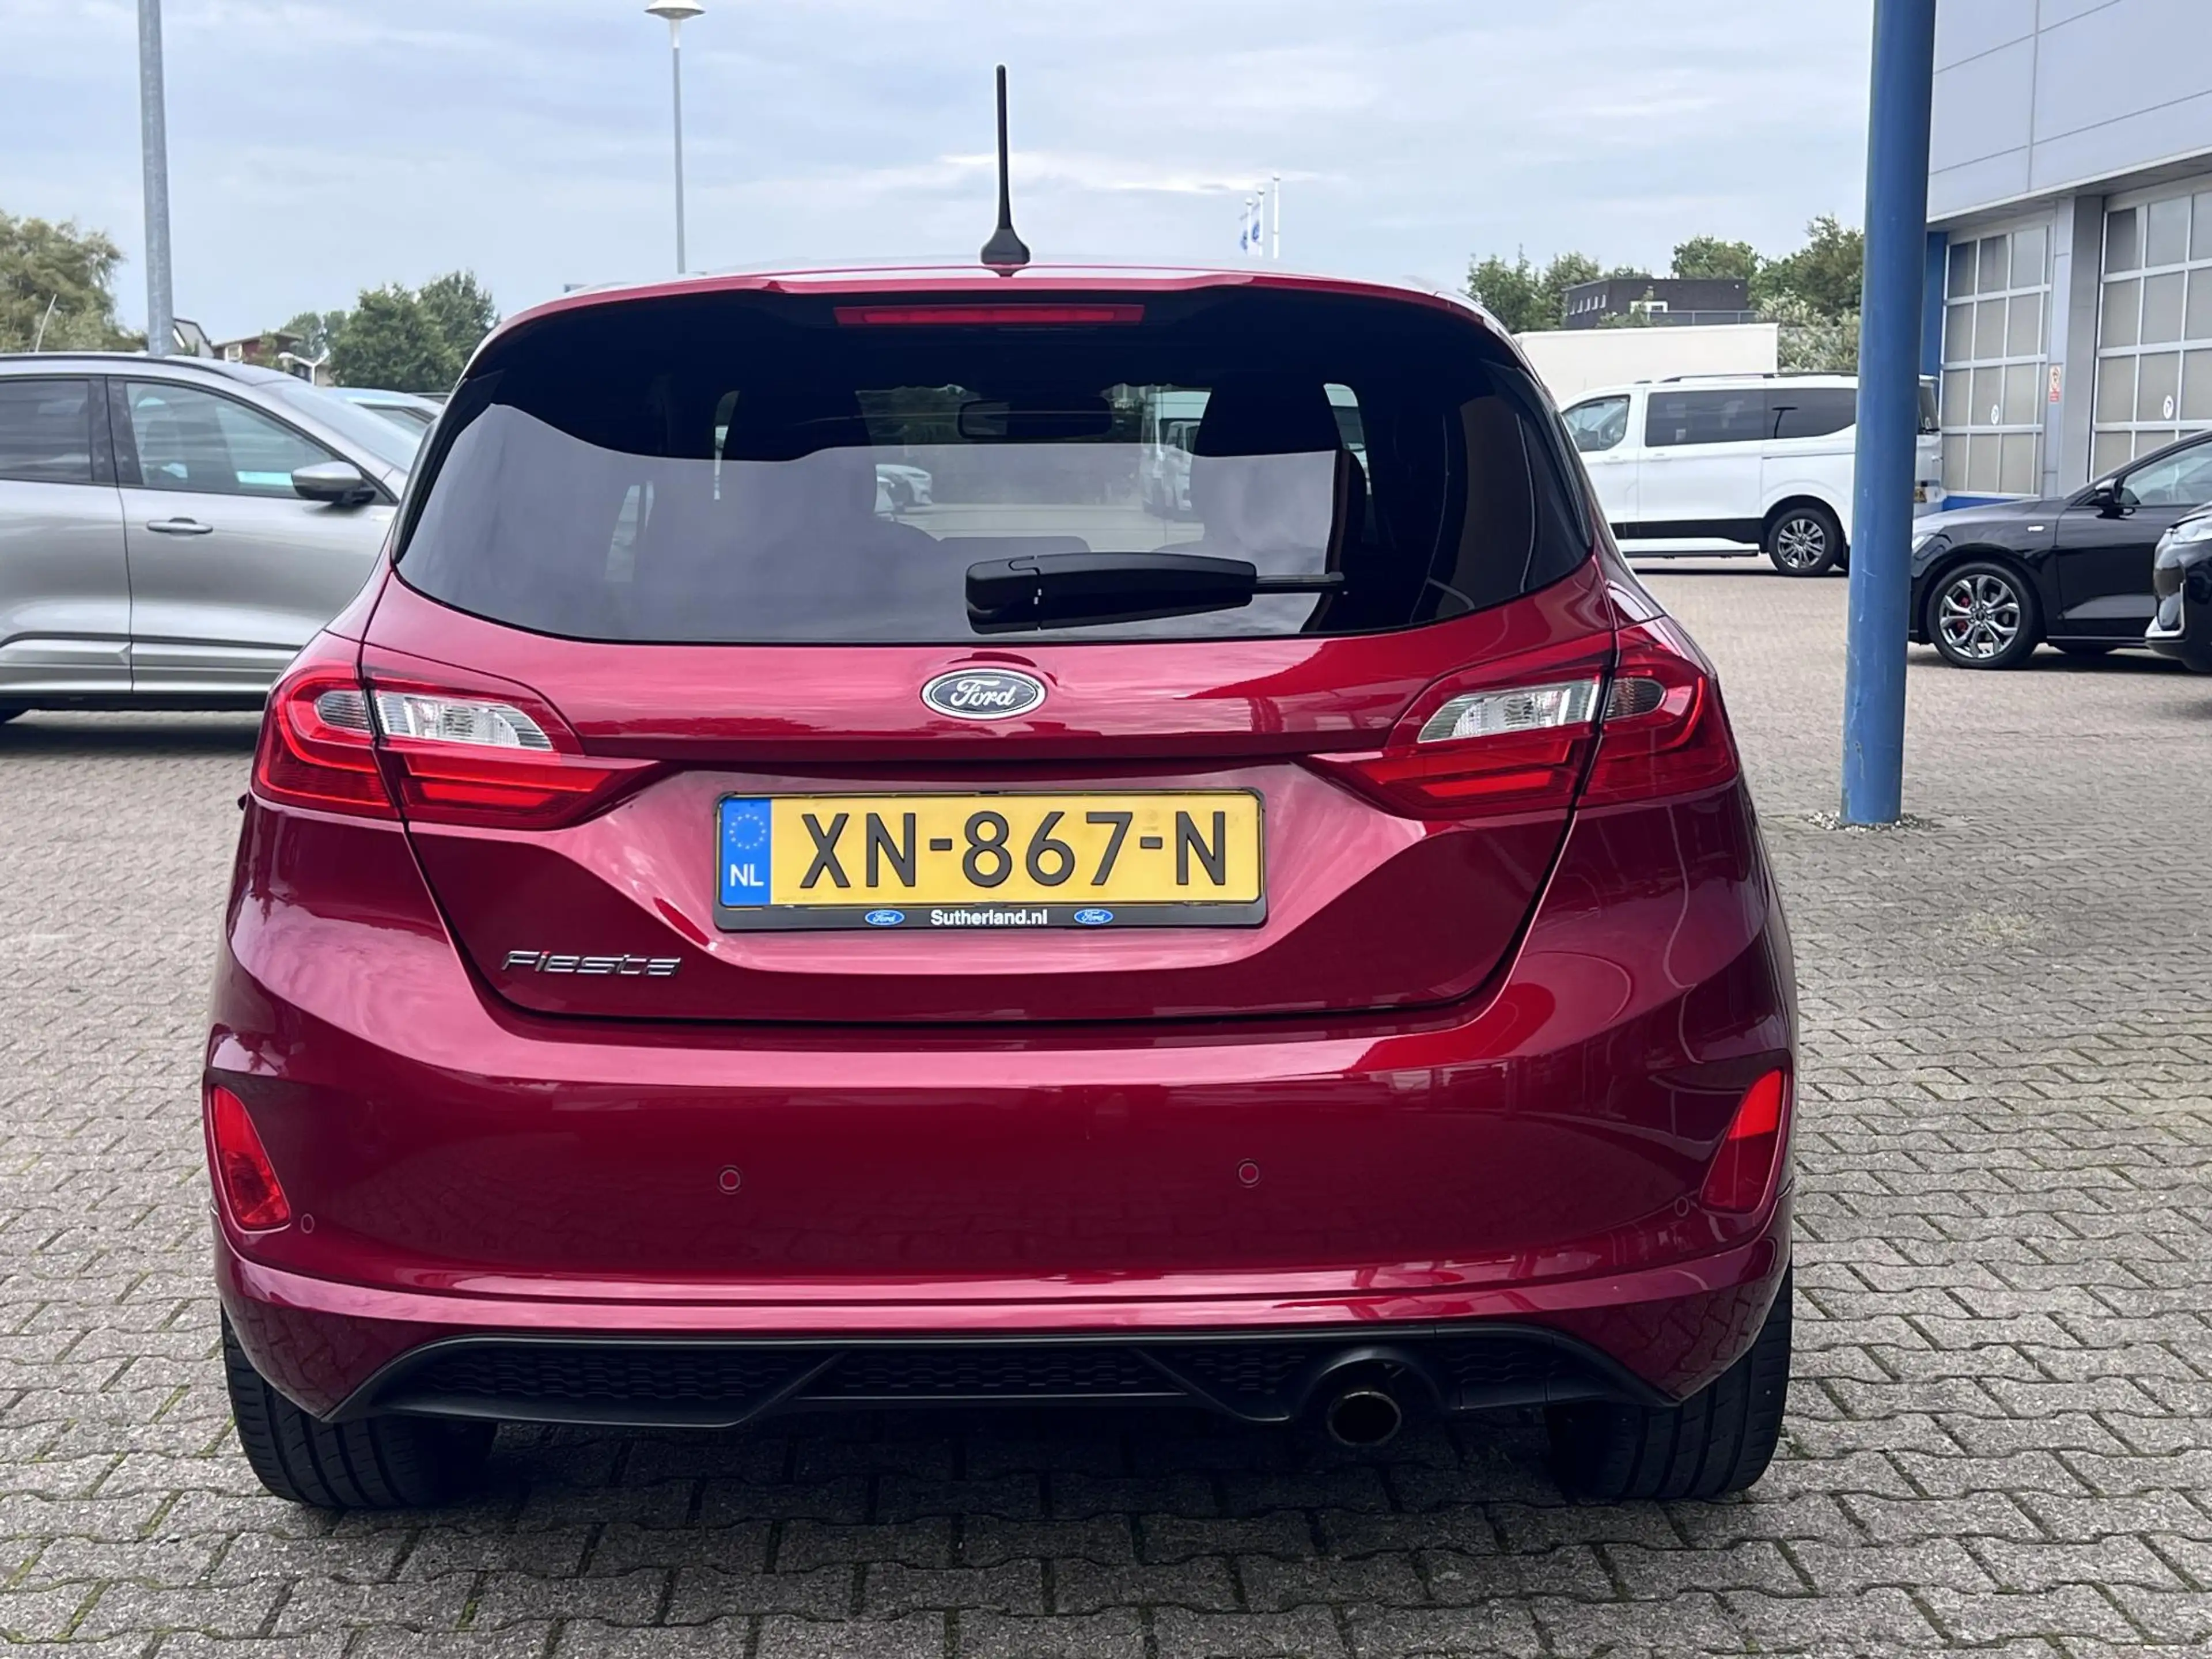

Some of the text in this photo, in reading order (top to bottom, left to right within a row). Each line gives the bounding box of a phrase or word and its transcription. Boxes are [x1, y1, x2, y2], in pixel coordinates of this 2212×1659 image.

[950, 679, 1017, 706] Ford
[800, 811, 1226, 888] XN-867-N
[730, 863, 765, 887] NL
[871, 909, 1107, 926] Ford Sutherland.nl Ford
[501, 950, 681, 976] Fiesta
